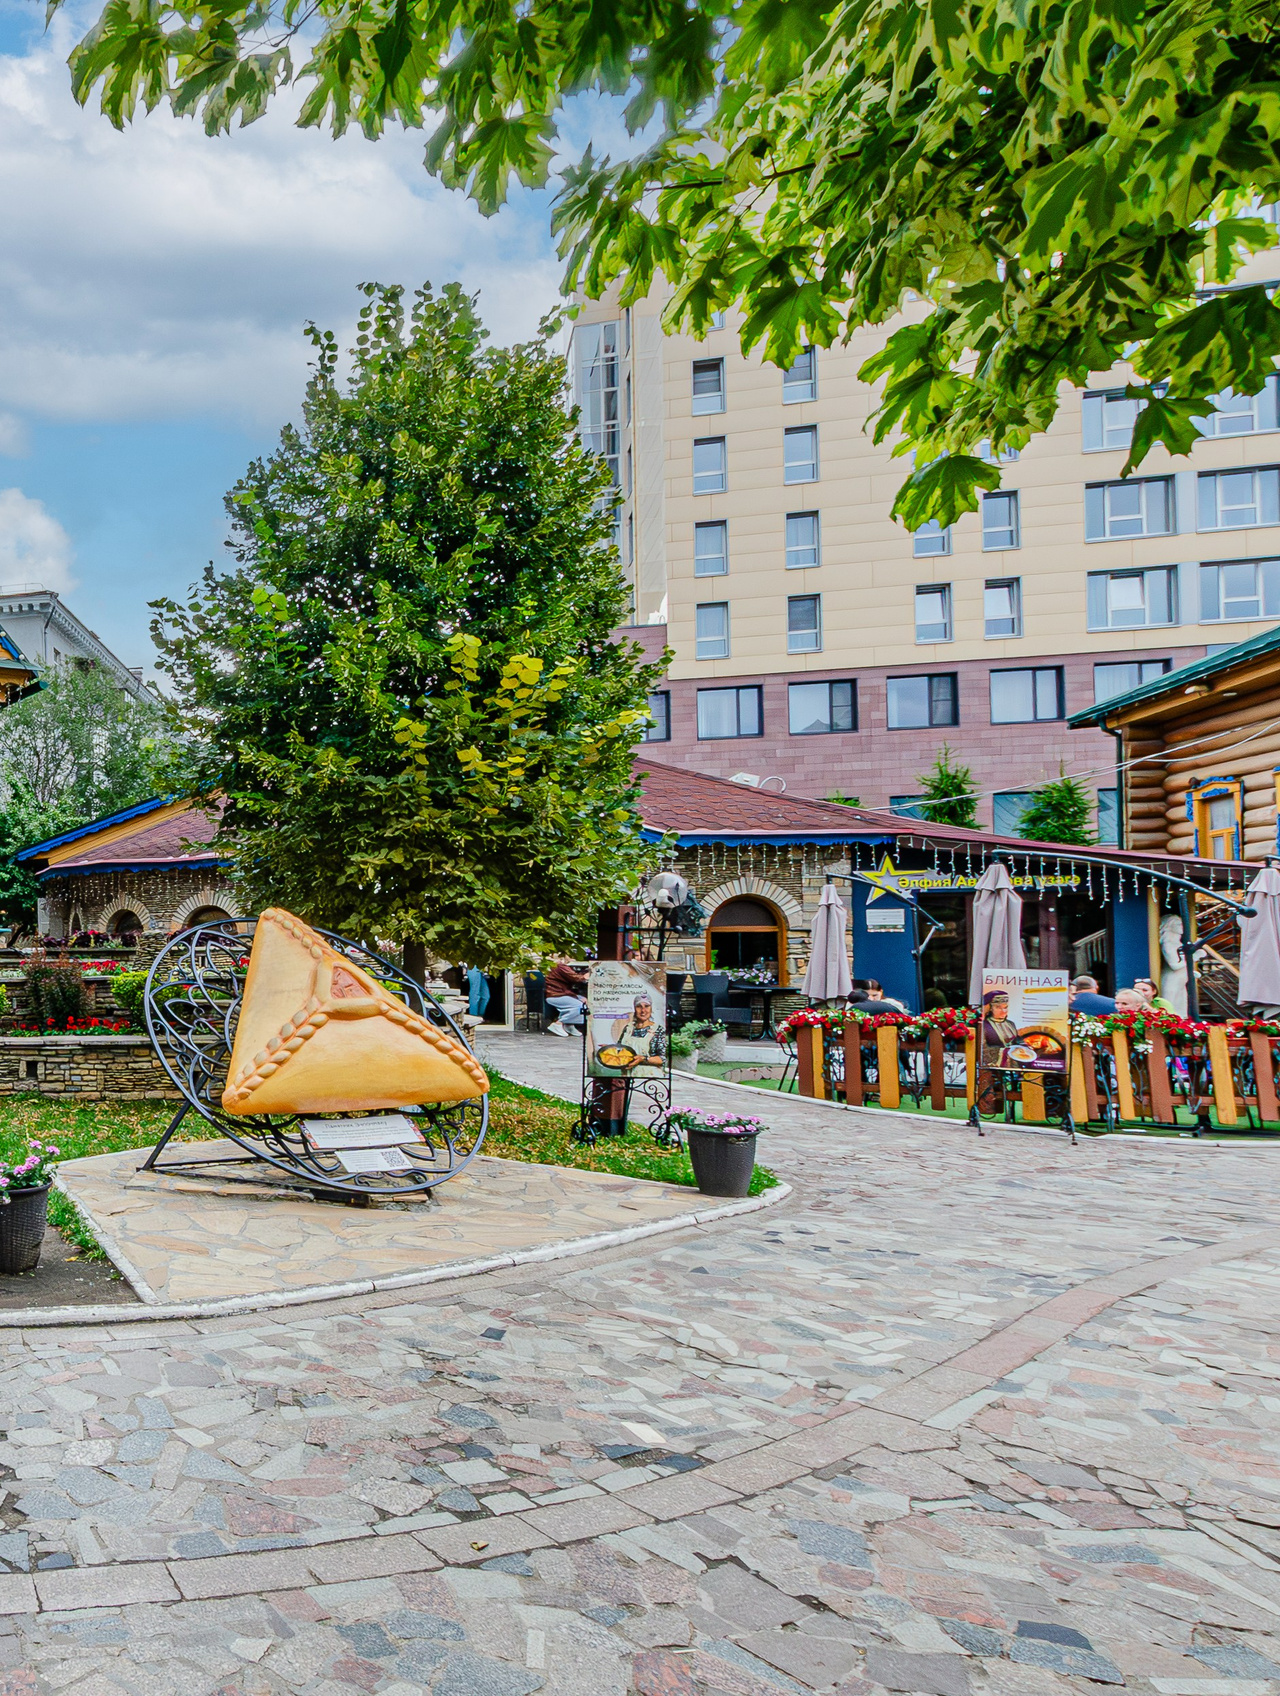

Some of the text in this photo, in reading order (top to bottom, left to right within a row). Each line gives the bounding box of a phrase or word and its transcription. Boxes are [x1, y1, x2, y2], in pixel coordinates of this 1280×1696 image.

[898, 875, 952, 889] Әлфия
[955, 874, 1034, 888] Авва
[984, 974, 1063, 987] БЛИННАЯ
